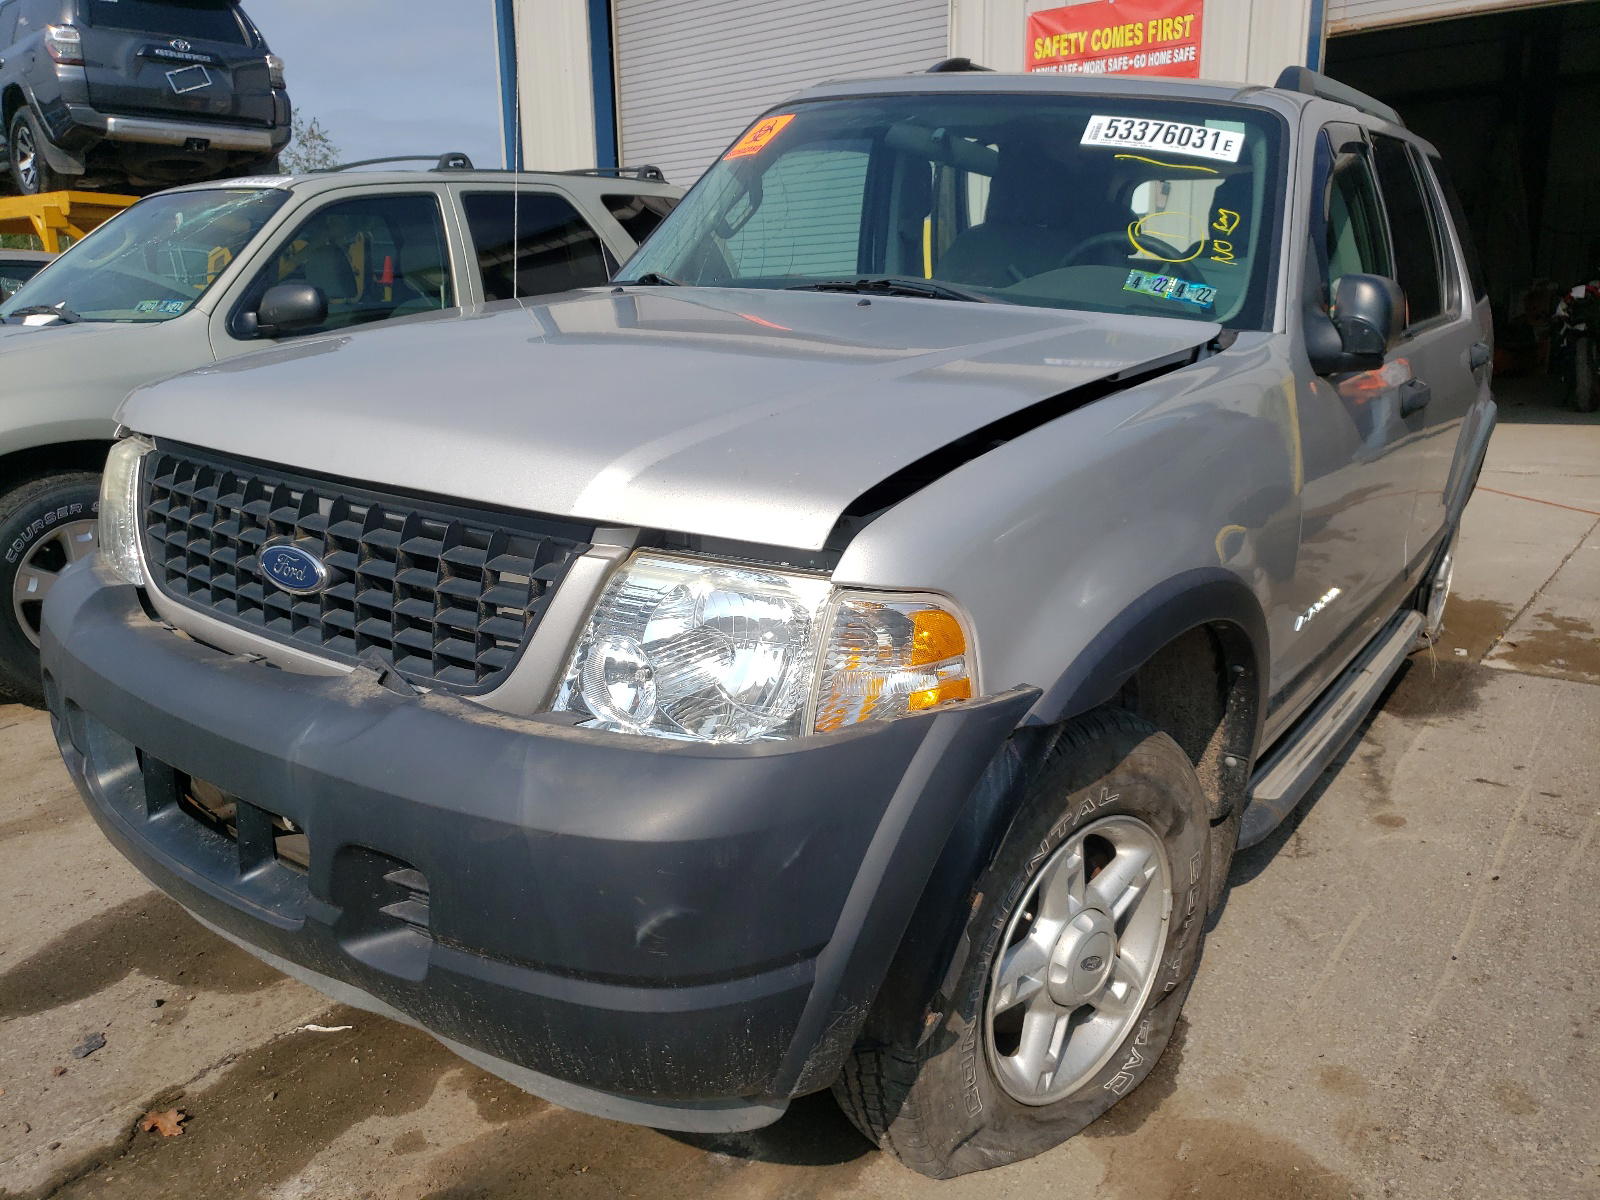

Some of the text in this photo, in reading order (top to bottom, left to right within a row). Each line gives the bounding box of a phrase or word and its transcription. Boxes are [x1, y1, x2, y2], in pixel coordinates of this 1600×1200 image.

[1033, 14, 1195, 60] SAFETY COMES FIRST
[1107, 55, 1129, 73] SAFE
[1133, 53, 1147, 69] GO
[1147, 49, 1173, 67] HOME
[1173, 46, 1196, 63] SAFE
[1103, 118, 1221, 152] 53376031
[1223, 140, 1234, 152] E
[1132, 276, 1169, 293] 4 22
[1175, 283, 1212, 303] 4 22
[5, 502, 83, 563] COURSER
[273, 553, 307, 581] Ford
